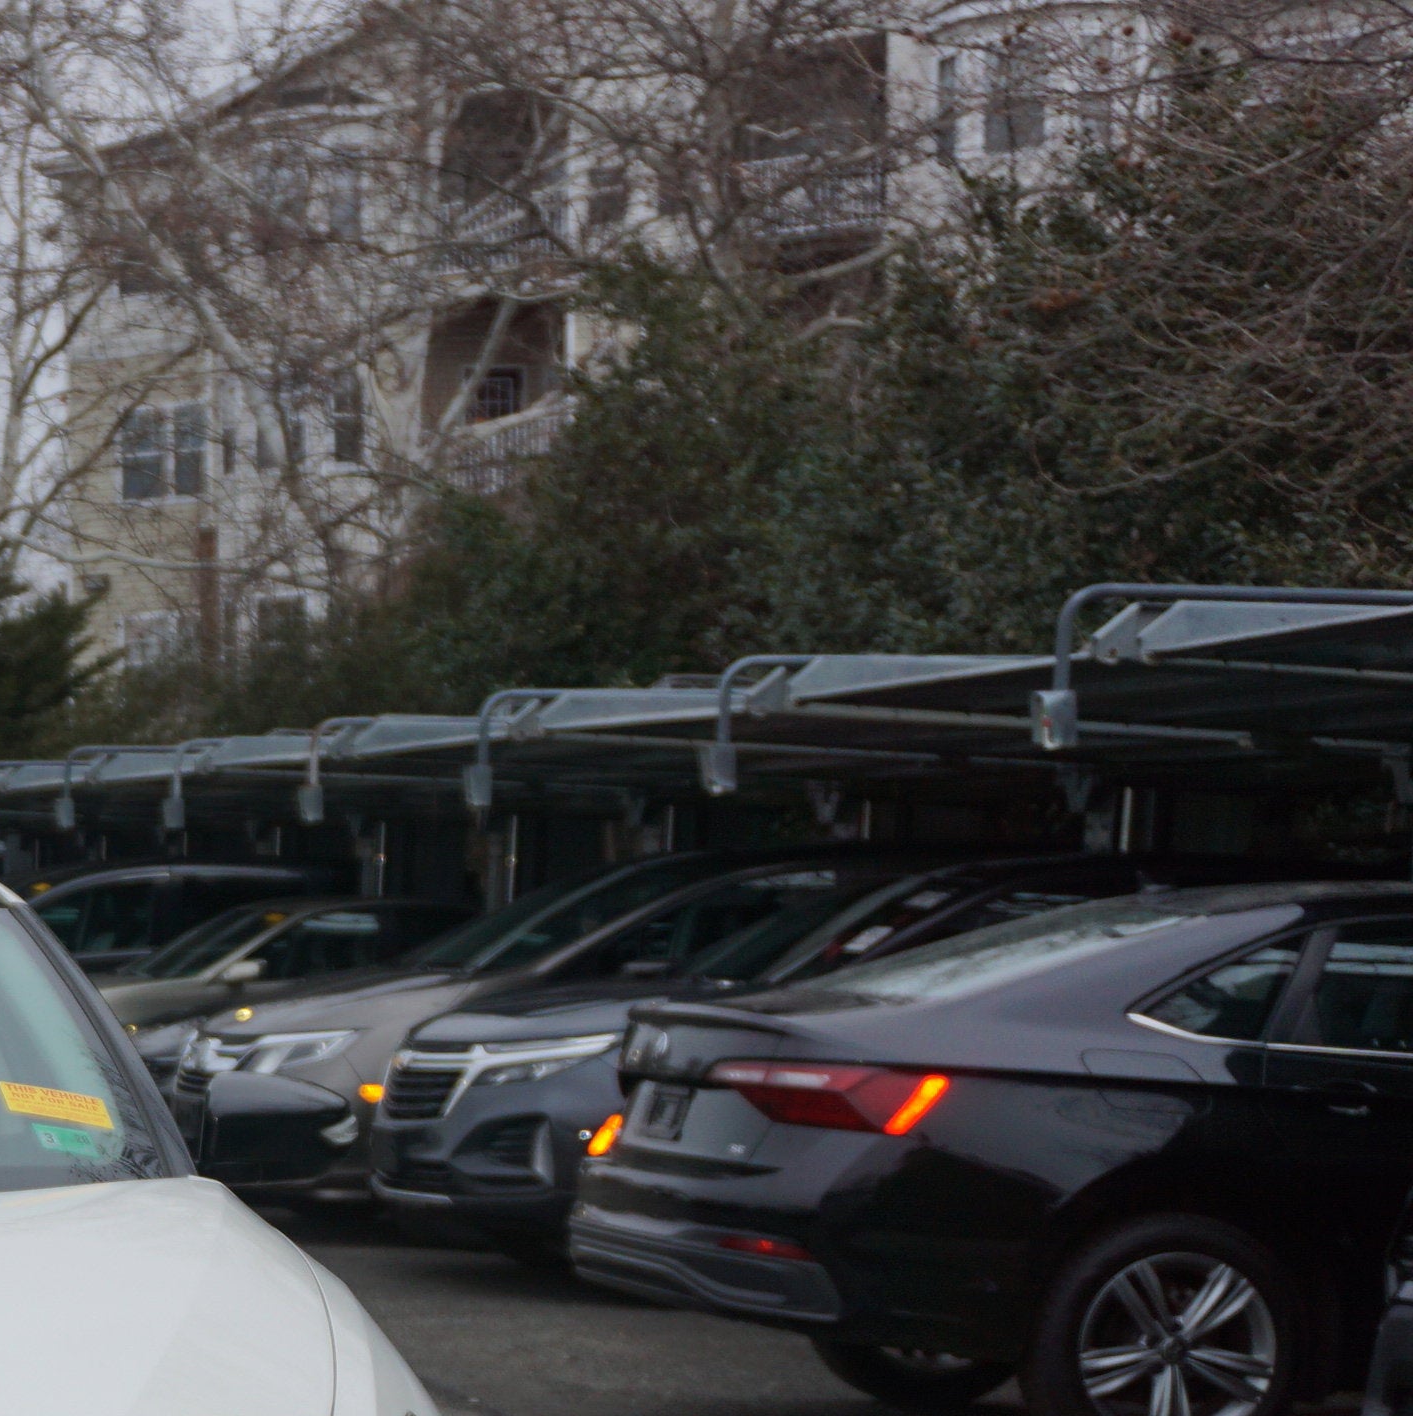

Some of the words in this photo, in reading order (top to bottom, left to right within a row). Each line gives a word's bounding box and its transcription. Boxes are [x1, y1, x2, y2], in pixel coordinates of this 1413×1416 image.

[4, 1084, 38, 1095] THIS
[39, 1088, 101, 1106] VEHICLE
[11, 1092, 36, 1100] NOT
[39, 1095, 65, 1105] FOR
[69, 1101, 99, 1112] SALE
[44, 1133, 55, 1143] 3
